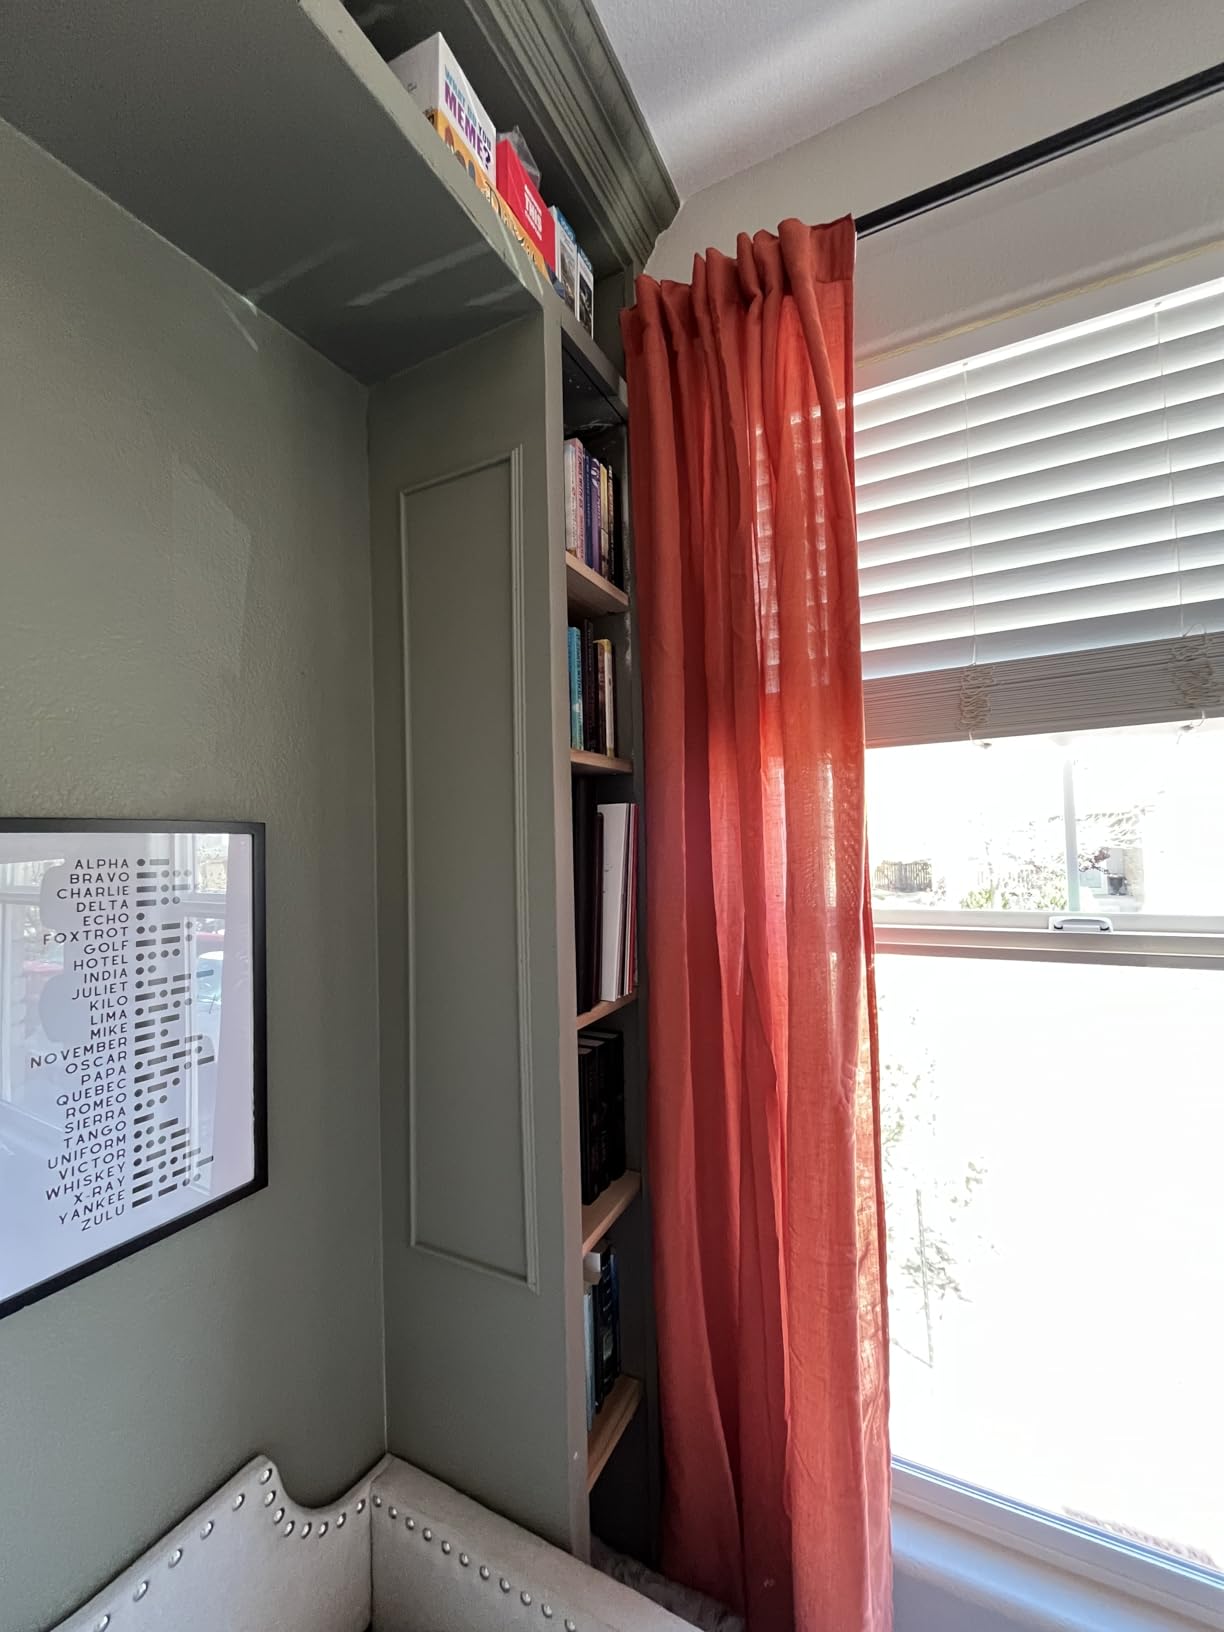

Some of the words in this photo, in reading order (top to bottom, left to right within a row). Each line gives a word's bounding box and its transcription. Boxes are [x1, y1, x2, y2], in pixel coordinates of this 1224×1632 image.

[444, 80, 491, 170] MEME?
[478, 122, 492, 151] YOU
[75, 858, 130, 870] ALPHA
[70, 872, 130, 884] BRAVO
[56, 885, 130, 899] CHARLIE
[77, 899, 129, 912] DELTA
[83, 913, 129, 925] ECHO
[43, 927, 129, 945] FOXTROT
[84, 940, 129, 954] GOLF
[73, 955, 129, 970] HOTEL
[84, 968, 128, 983] INDIA
[72, 982, 128, 1000] JULIET
[89, 996, 128, 1011] KILO
[90, 1010, 128, 1025] LIMA
[90, 1023, 128, 1039] MIKE
[30, 1037, 128, 1068] NOVEMBER
[65, 1051, 128, 1074] OSCAR
[81, 1066, 127, 1085] PAPA
[56, 1079, 127, 1107] QUEBEC
[66, 1092, 127, 1118] ROMEO
[64, 1107, 126, 1133] SIERRA
[64, 1121, 126, 1148] TANGO
[47, 1134, 126, 1169] UNIFORM
[59, 1148, 126, 1179] VICTOR
[45, 1163, 126, 1201] WHISKEY
[73, 1177, 125, 1205] X-RAY
[58, 1190, 125, 1225] YANKEE
[81, 1205, 125, 1231] ZULU
